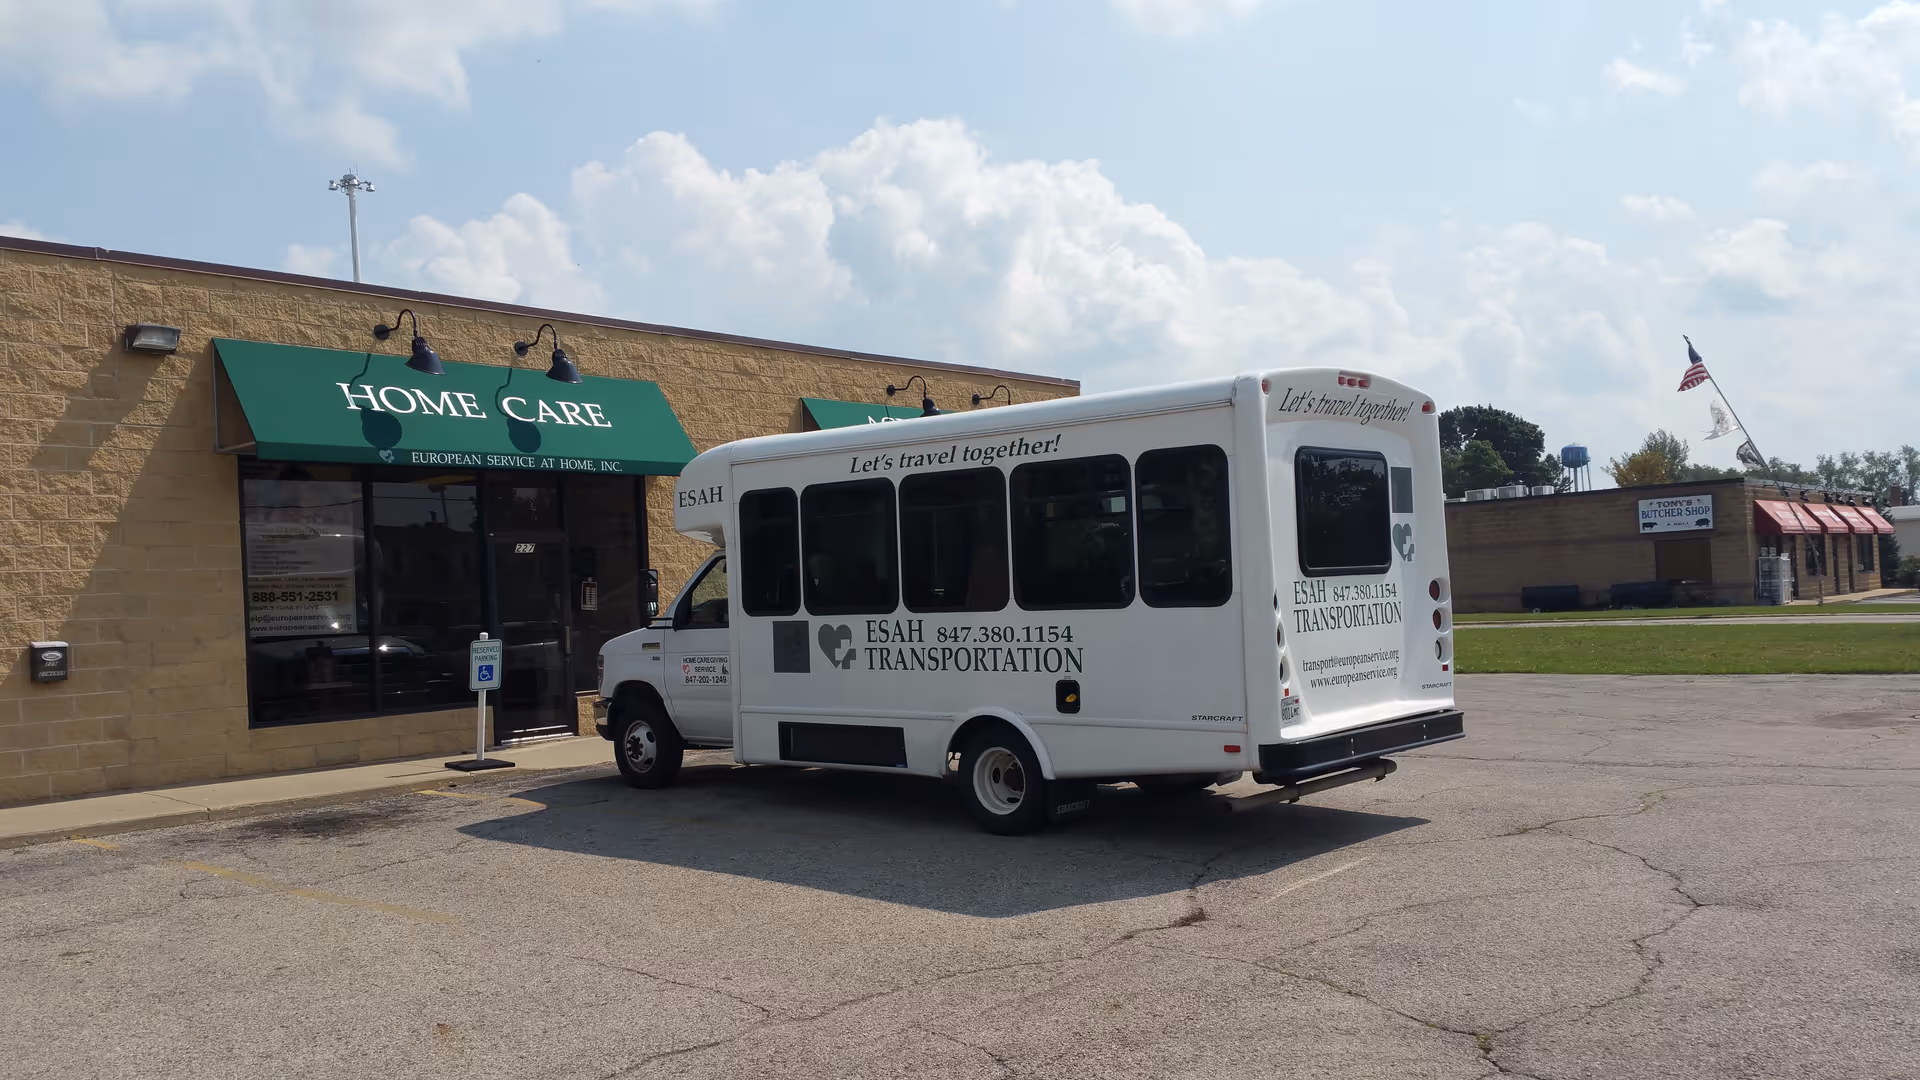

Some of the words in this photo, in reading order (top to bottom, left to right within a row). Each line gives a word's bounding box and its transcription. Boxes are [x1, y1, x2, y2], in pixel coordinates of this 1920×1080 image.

[336, 382, 487, 419] HOME
[502, 396, 613, 428] CARE
[1278, 387, 1315, 414] Let's
[1316, 394, 1358, 417] travel
[1357, 399, 1414, 425] together!
[411, 451, 482, 467] EUROPEAN
[487, 455, 536, 469] SERVICE
[540, 457, 555, 469] AT
[560, 458, 597, 472] HOME,
[601, 460, 623, 472] INC.
[850, 454, 894, 474] Let's
[898, 446, 956, 468] travel
[962, 434, 1062, 466] together!
[678, 485, 724, 509] ESAH
[1656, 500, 1693, 508] TONY'S
[1641, 508, 1683, 519] BUTCHER
[1685, 506, 1711, 516] SHOP
[516, 544, 535, 553] 227
[252, 590, 338, 602] 888-551-2531
[1293, 580, 1327, 604] ESAH
[1333, 583, 1398, 603] 847.380.1154
[1293, 602, 1402, 633] TRANSPORTATION
[866, 619, 925, 644] ESAH
[937, 625, 1074, 644] 847.380.1154
[472, 645, 500, 654] RESERVED
[474, 654, 498, 662] PARKING
[864, 646, 1084, 674] TRANSPORTATION
[1302, 649, 1399, 673] transport@europeanservice.org
[685, 676, 727, 684] 847-202-1249
[1310, 665, 1398, 689] www.europeanservice.org
[1421, 681, 1452, 690] STARCRAFT
[1191, 714, 1244, 722] STARCRAFT
